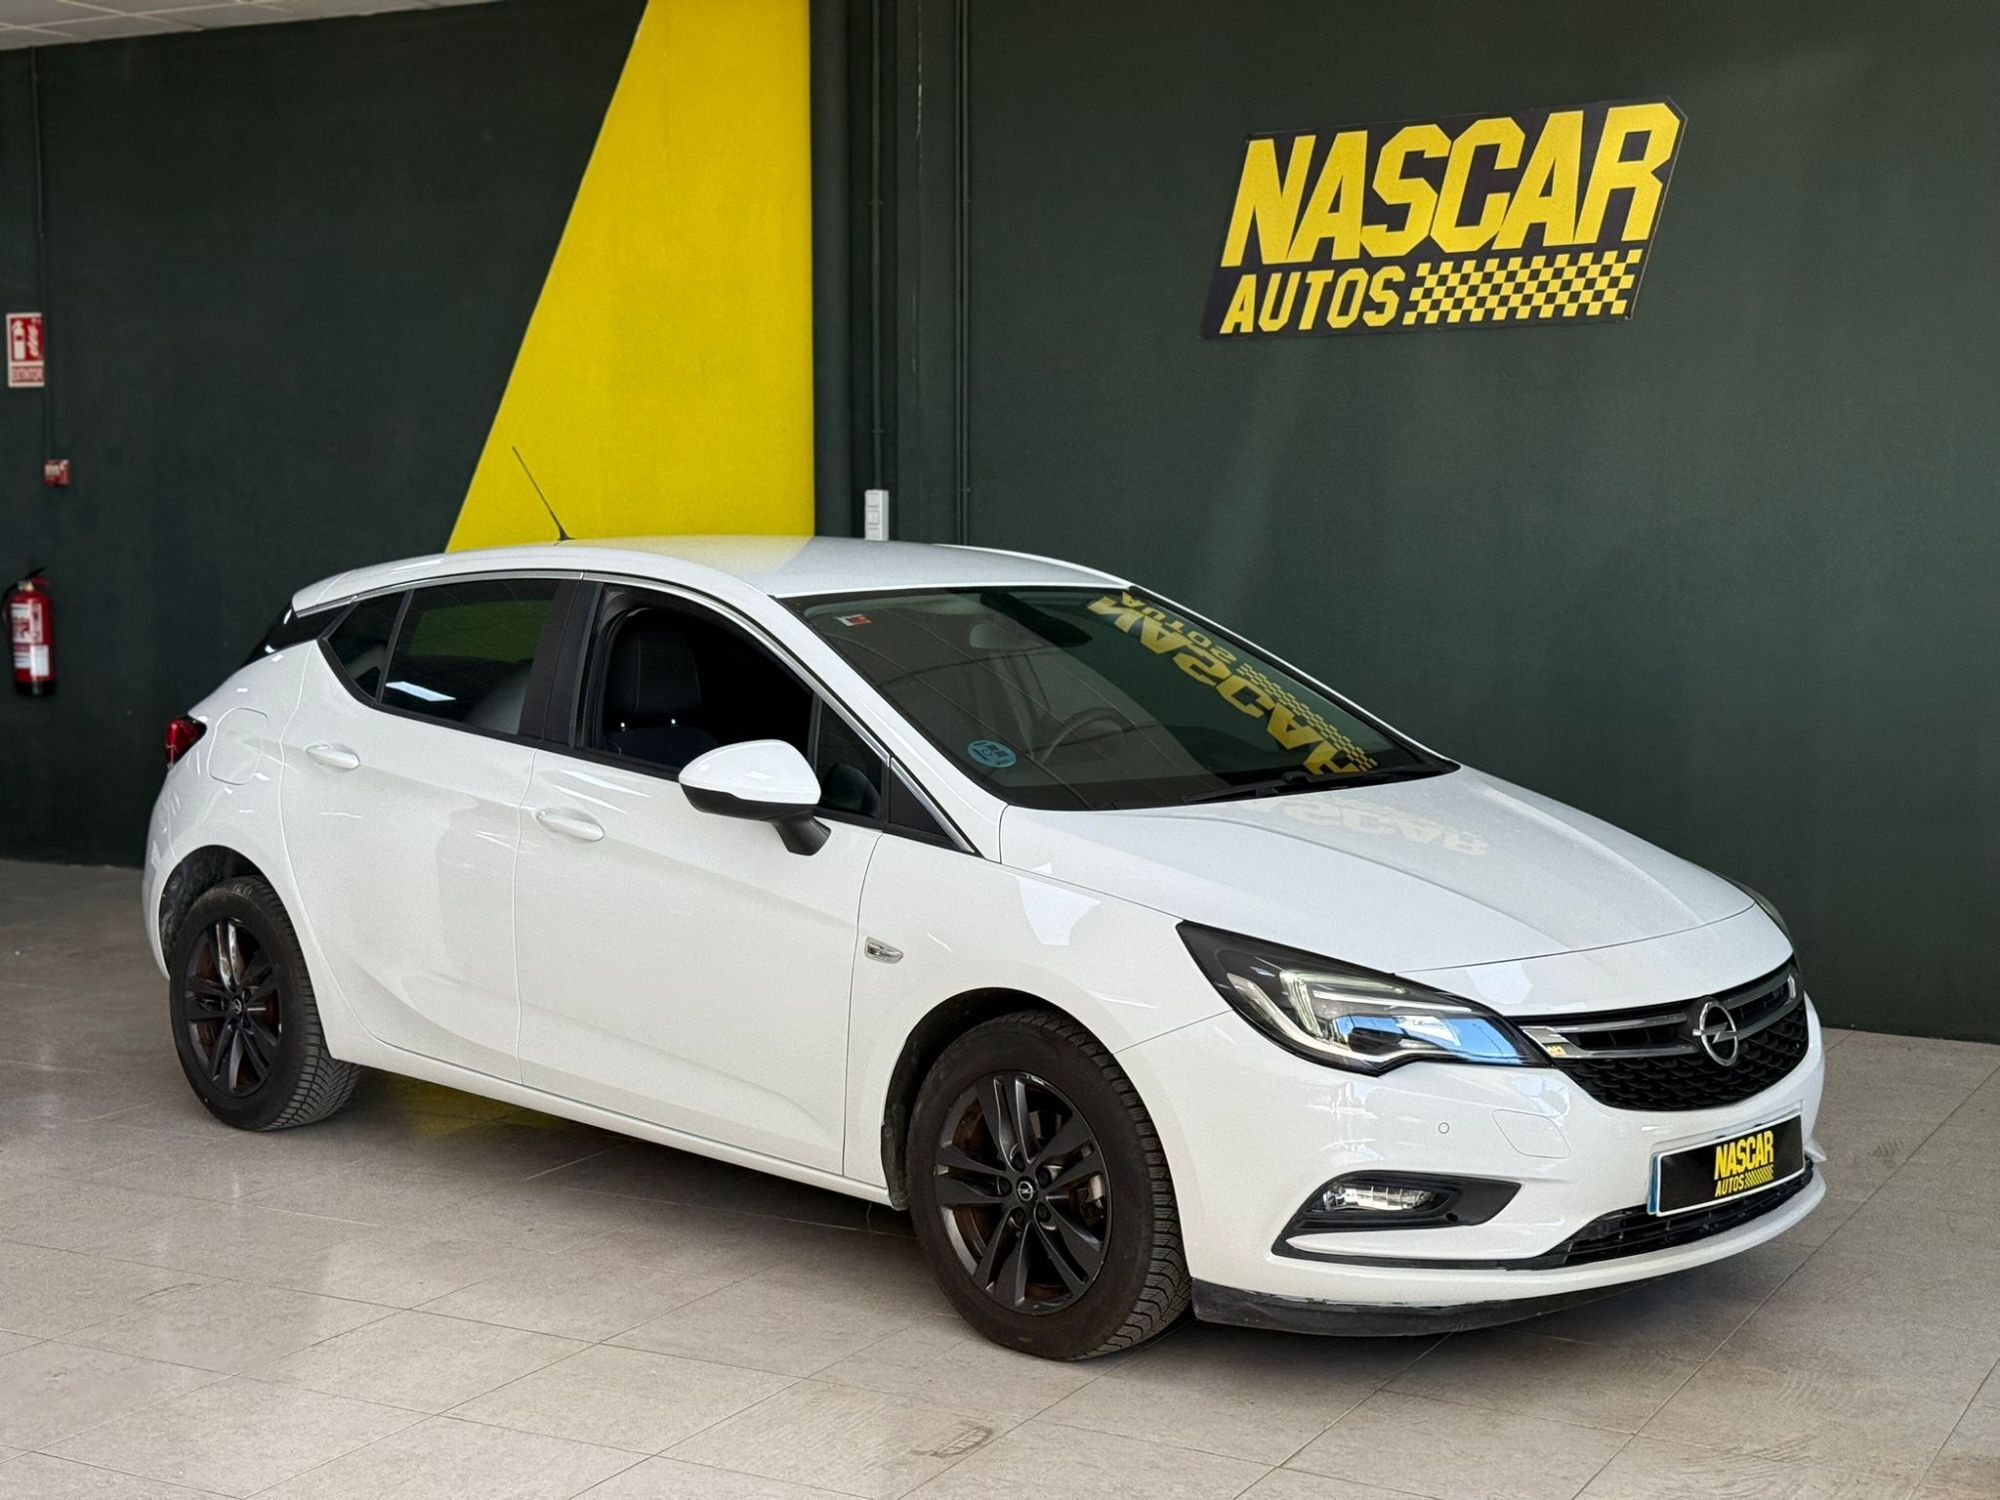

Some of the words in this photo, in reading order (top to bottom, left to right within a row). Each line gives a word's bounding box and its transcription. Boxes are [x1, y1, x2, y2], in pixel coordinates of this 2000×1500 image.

[1220, 102, 1681, 267] NASCAR
[1219, 266, 1405, 334] AUTOS
[1714, 1130, 1774, 1180] NASCAR
[1714, 1174, 1745, 1197] AUTOS
